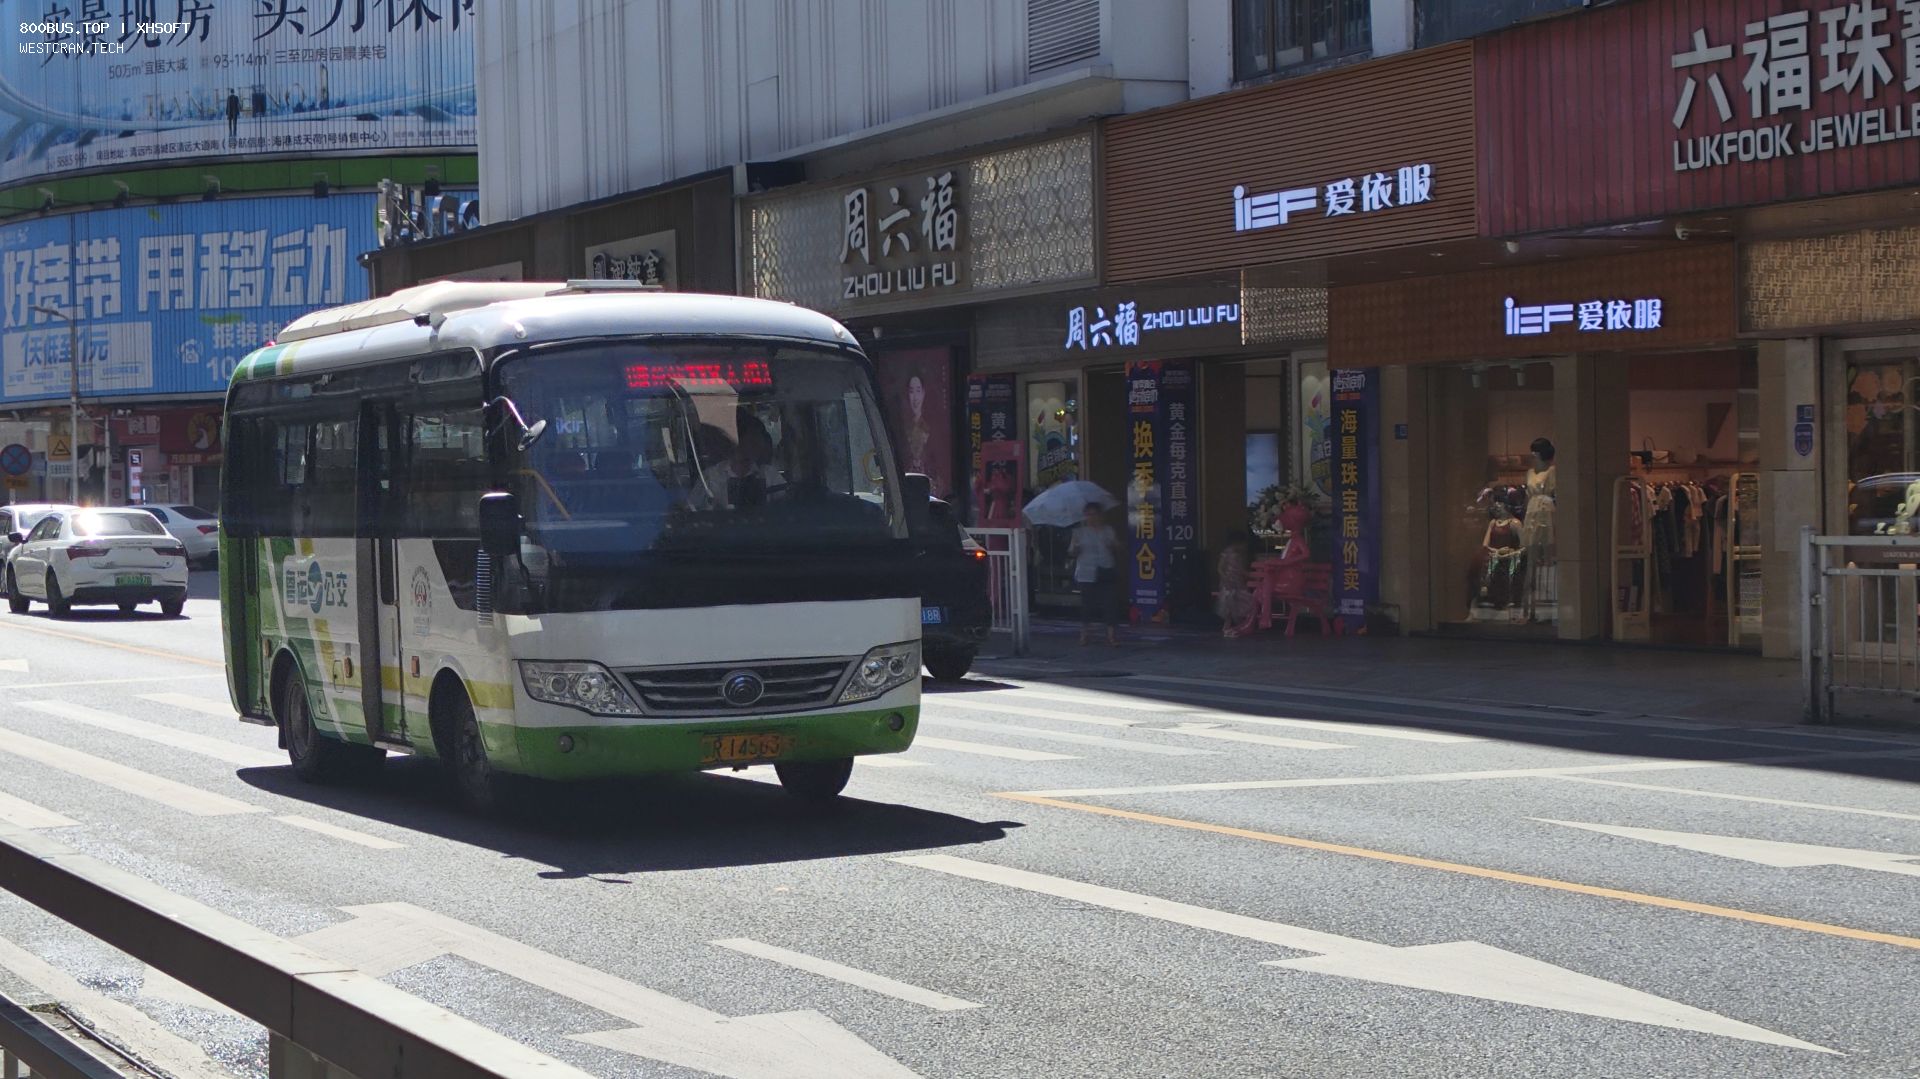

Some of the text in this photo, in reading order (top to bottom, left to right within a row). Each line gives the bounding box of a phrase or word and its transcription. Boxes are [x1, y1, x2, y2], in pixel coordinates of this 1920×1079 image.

[1672, 123, 1794, 172] LUKFOOK
[840, 171, 958, 265] 周六福
[1324, 162, 1434, 218] 爱依服
[2, 222, 347, 333] 好宽带 用移动
[844, 262, 957, 299] ZHOU LIU FU
[1066, 301, 1239, 350] 周六福 ZHOU LIU FU
[1578, 298, 1663, 331] 爱依服
[1133, 421, 1156, 581] 换季清仓
[1341, 409, 1360, 591] 海量珠宝底价卖
